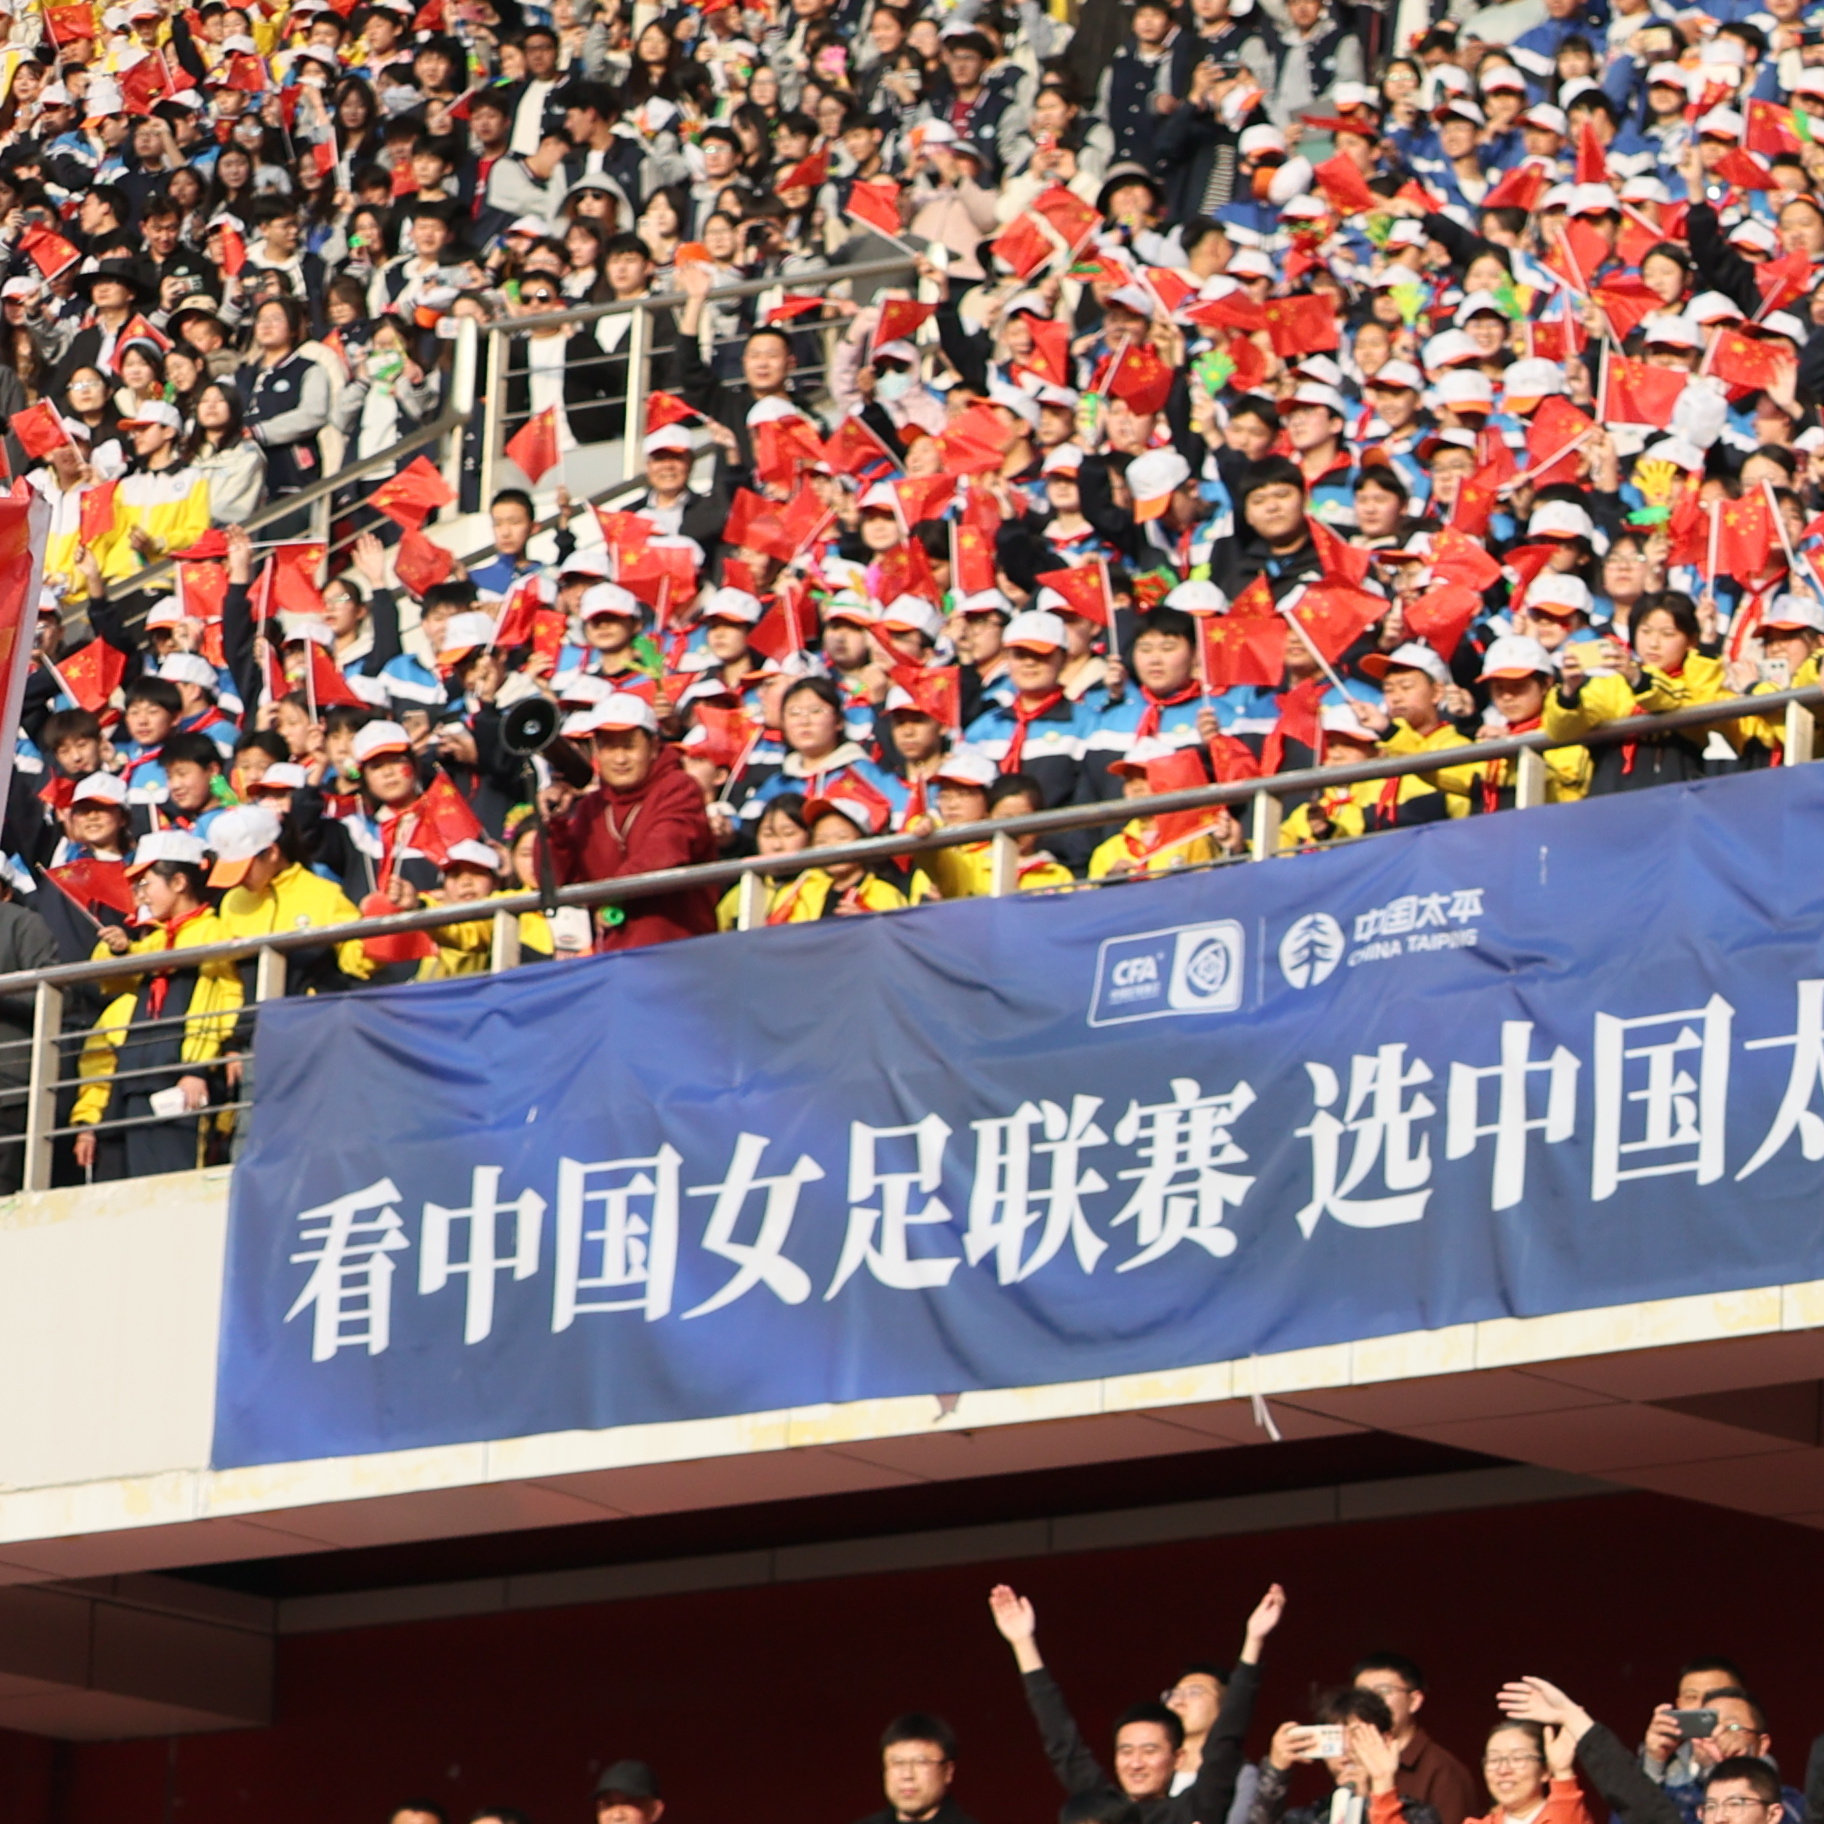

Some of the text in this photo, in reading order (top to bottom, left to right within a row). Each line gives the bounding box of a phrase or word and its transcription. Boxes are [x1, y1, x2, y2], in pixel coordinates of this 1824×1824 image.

[1353, 888, 1484, 941] 中国太平
[1347, 928, 1479, 967] CHINA TAIPING
[1111, 955, 1159, 987] CFA
[284, 1078, 1257, 1362] 看中国女足联赛
